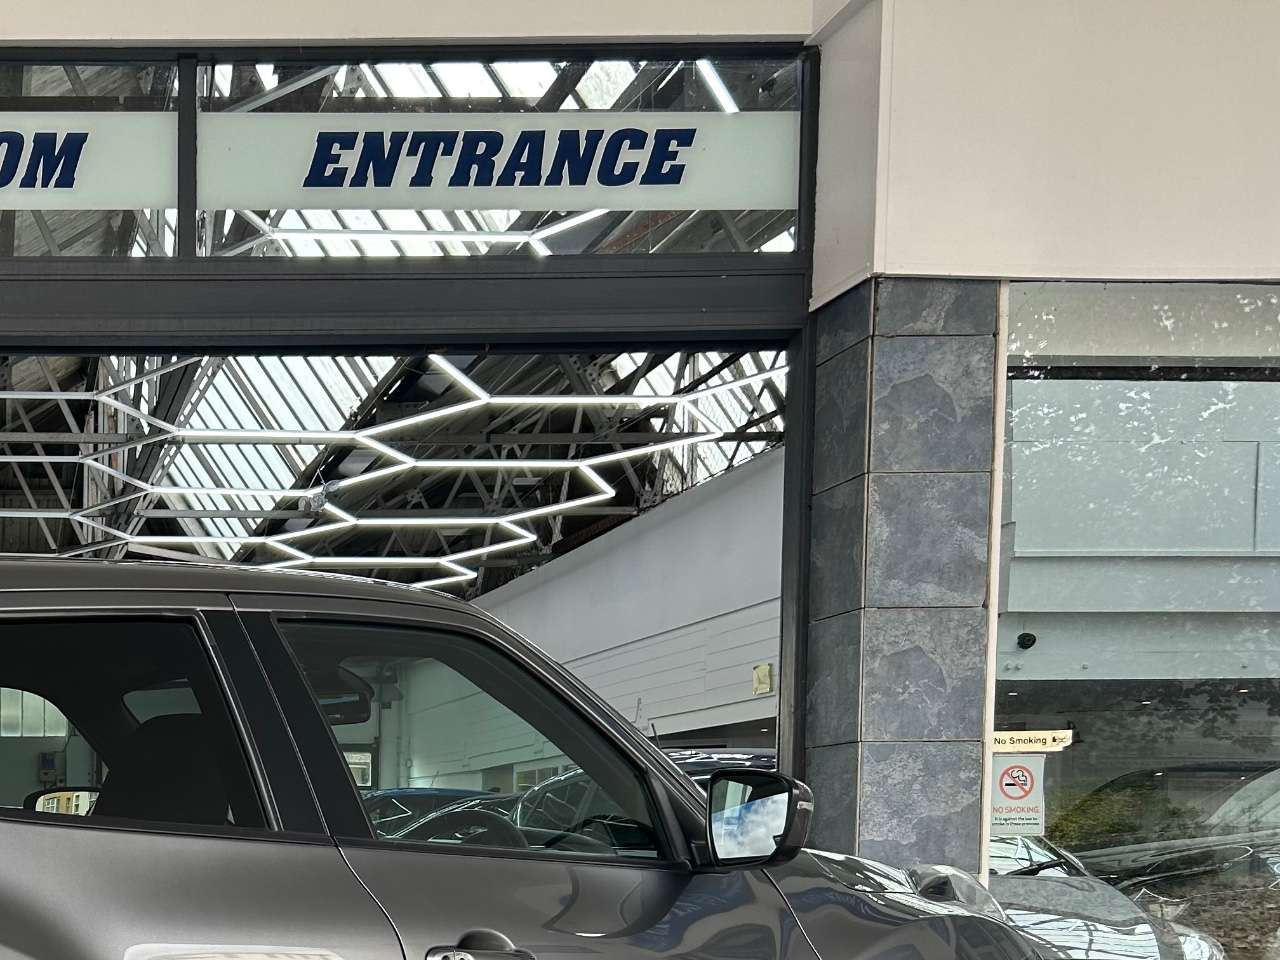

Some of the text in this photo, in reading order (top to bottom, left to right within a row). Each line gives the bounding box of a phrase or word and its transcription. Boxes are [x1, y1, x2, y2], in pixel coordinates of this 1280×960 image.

[302, 128, 697, 187] ENTRANCE
[994, 737, 1047, 746] No Smoking
